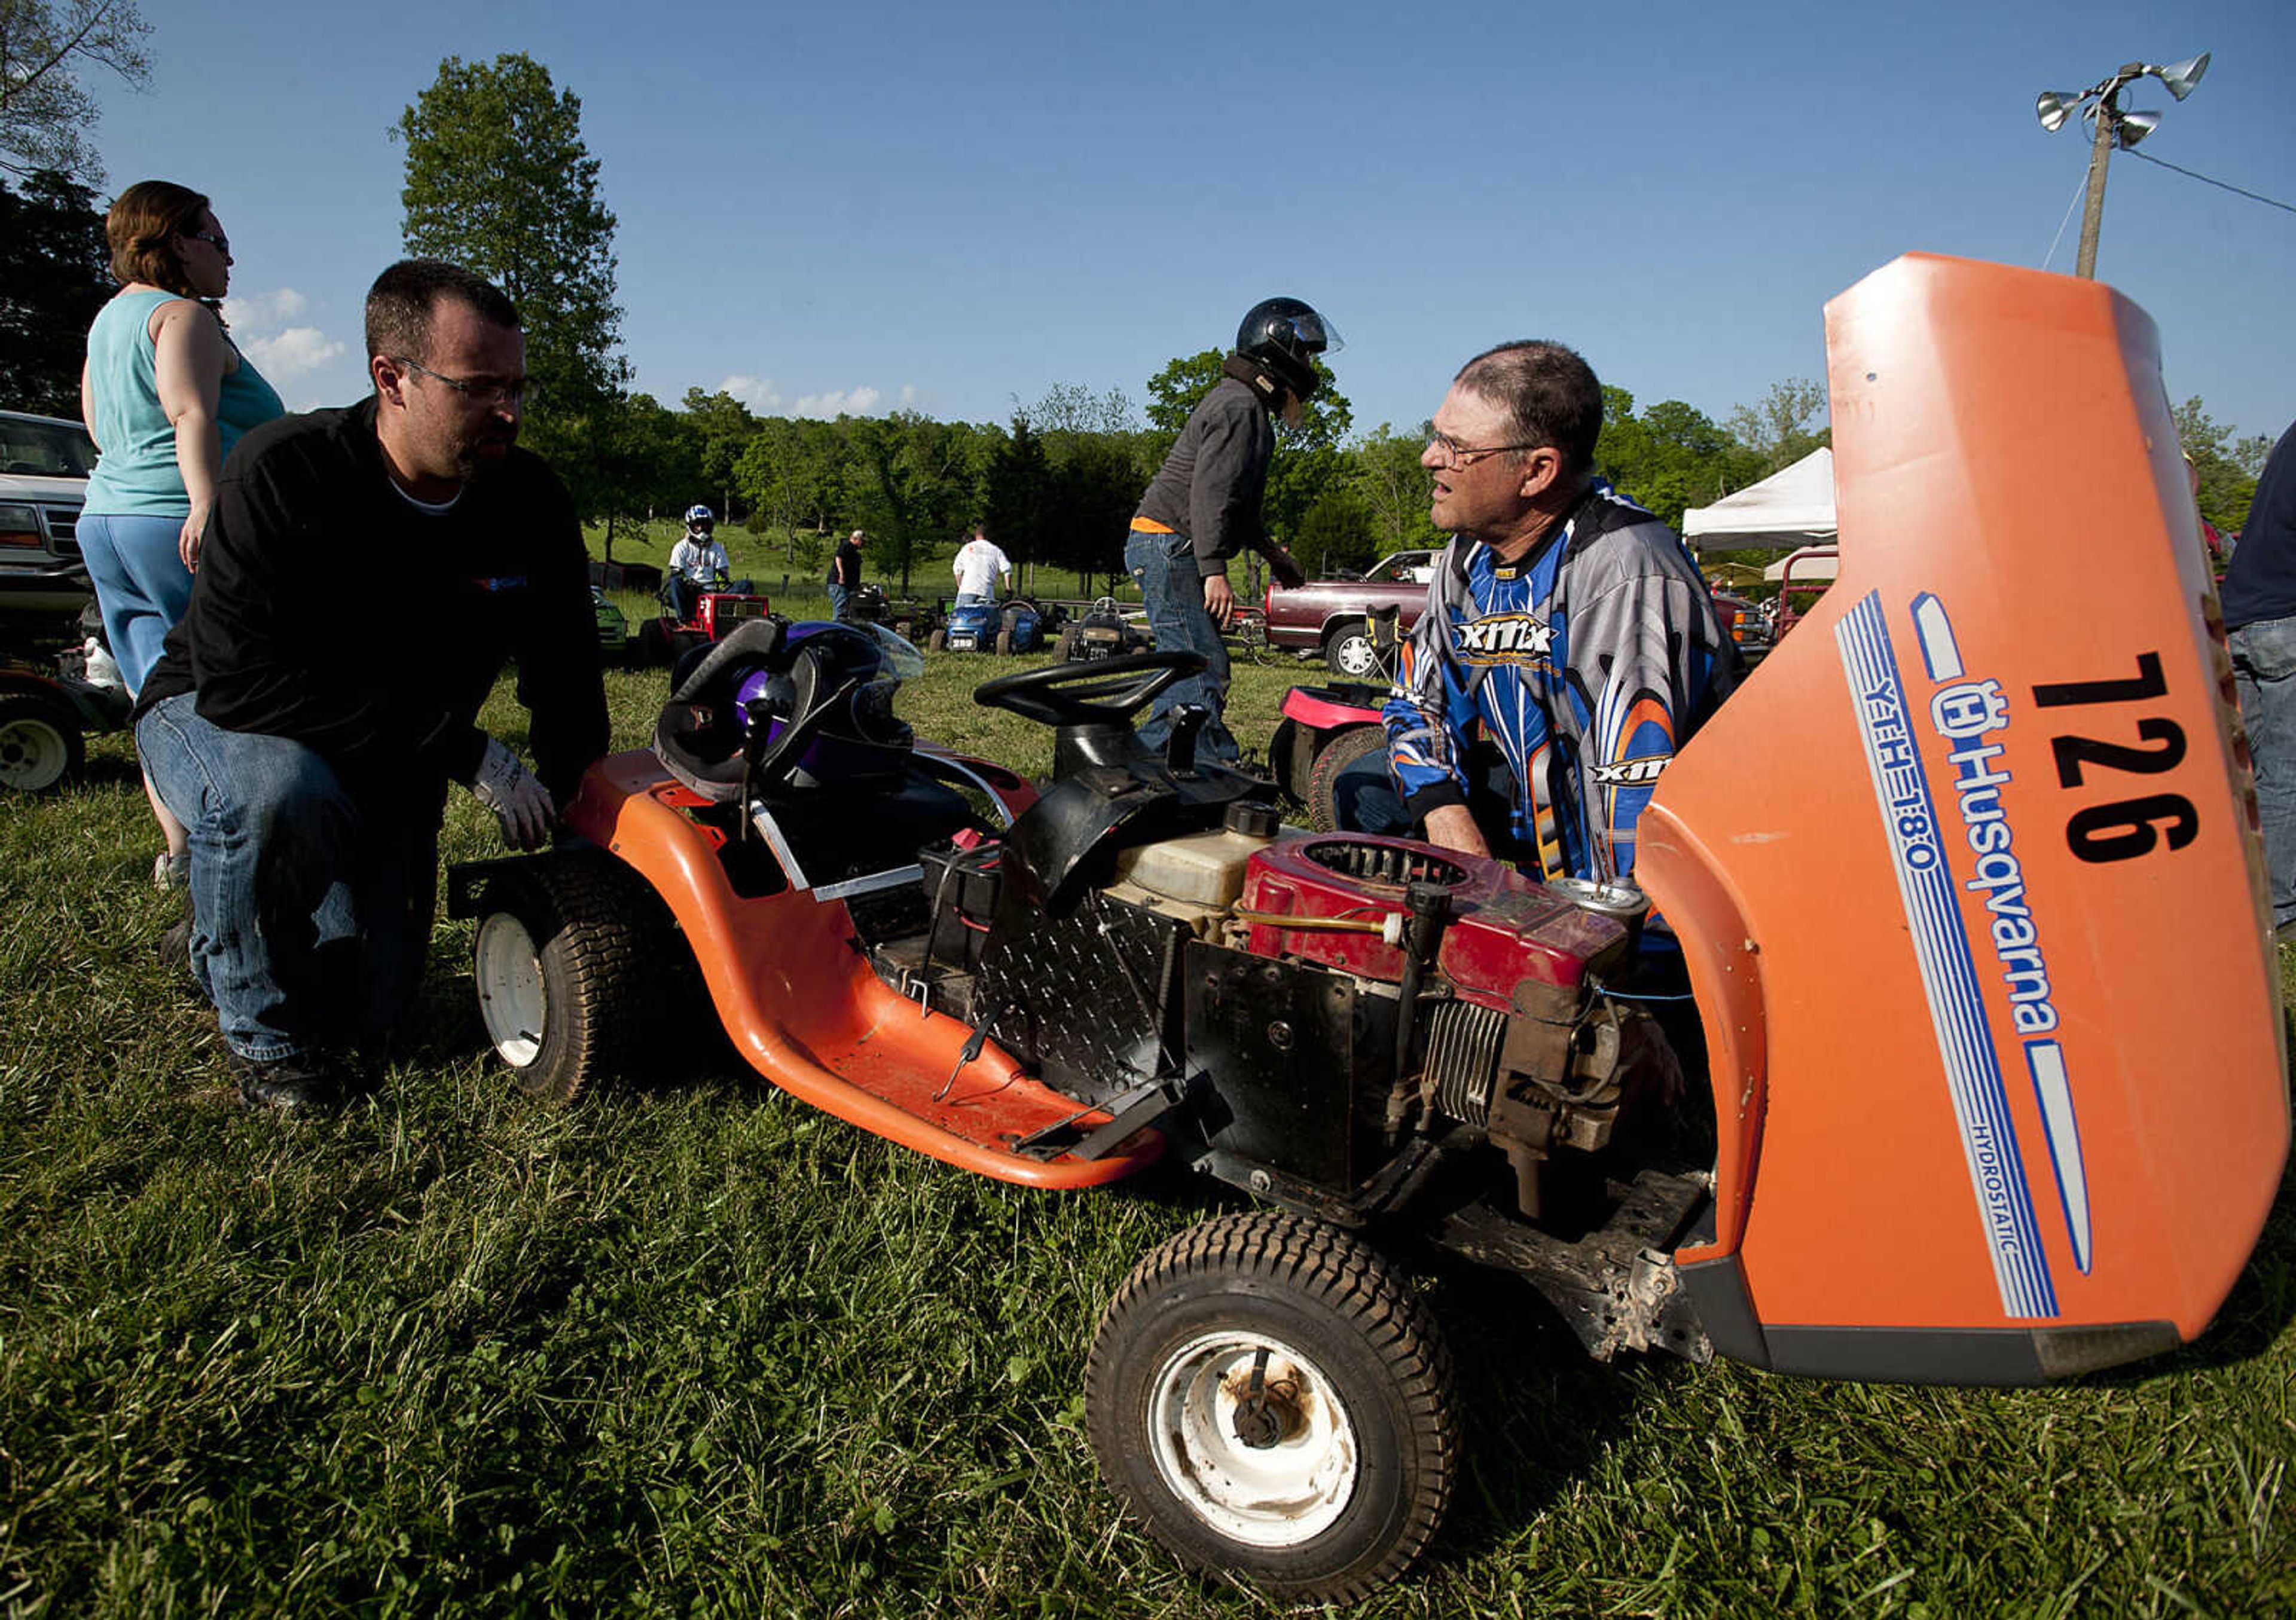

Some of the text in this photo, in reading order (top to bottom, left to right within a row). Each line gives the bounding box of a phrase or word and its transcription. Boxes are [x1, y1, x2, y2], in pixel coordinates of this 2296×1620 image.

[1866, 680, 1937, 870] YTH 180
[2032, 650, 2199, 863] 126
[1948, 743, 2060, 1035] Husqvarna
[1972, 1126, 2018, 1251] HYDROSTATIC
